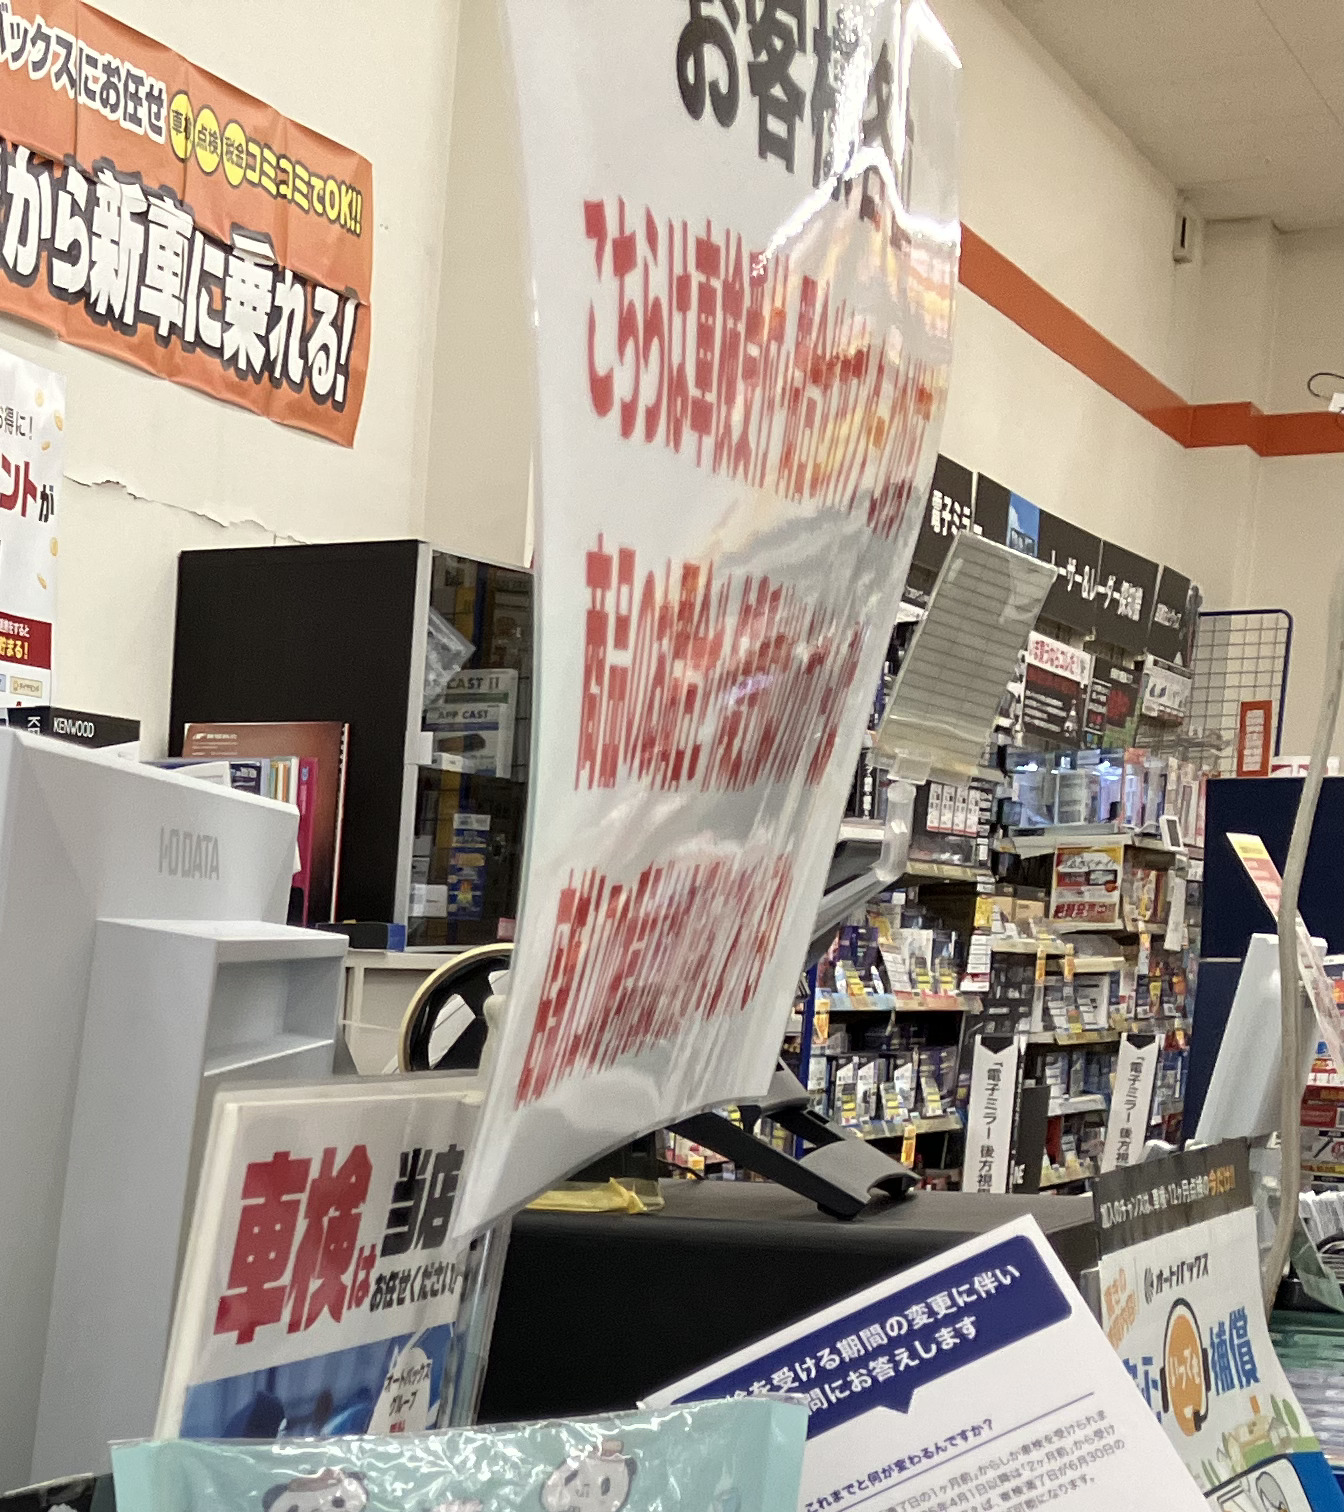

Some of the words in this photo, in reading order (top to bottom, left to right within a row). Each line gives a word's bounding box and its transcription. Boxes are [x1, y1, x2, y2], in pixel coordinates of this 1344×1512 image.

[195, 124, 221, 158] 点検
[223, 140, 249, 173] 税金
[246, 145, 364, 235] コミコミでOK!!
[1, 143, 360, 406] から新車に乗れる!
[52, 715, 96, 740] KENWOOD
[462, 708, 490, 722] CAST
[182, 830, 221, 881] DATA
[213, 1143, 378, 1345] 車検は
[381, 1143, 465, 1259] 当店
[369, 1260, 459, 1314] お任せください
[1155, 1252, 1210, 1296] オートバックス
